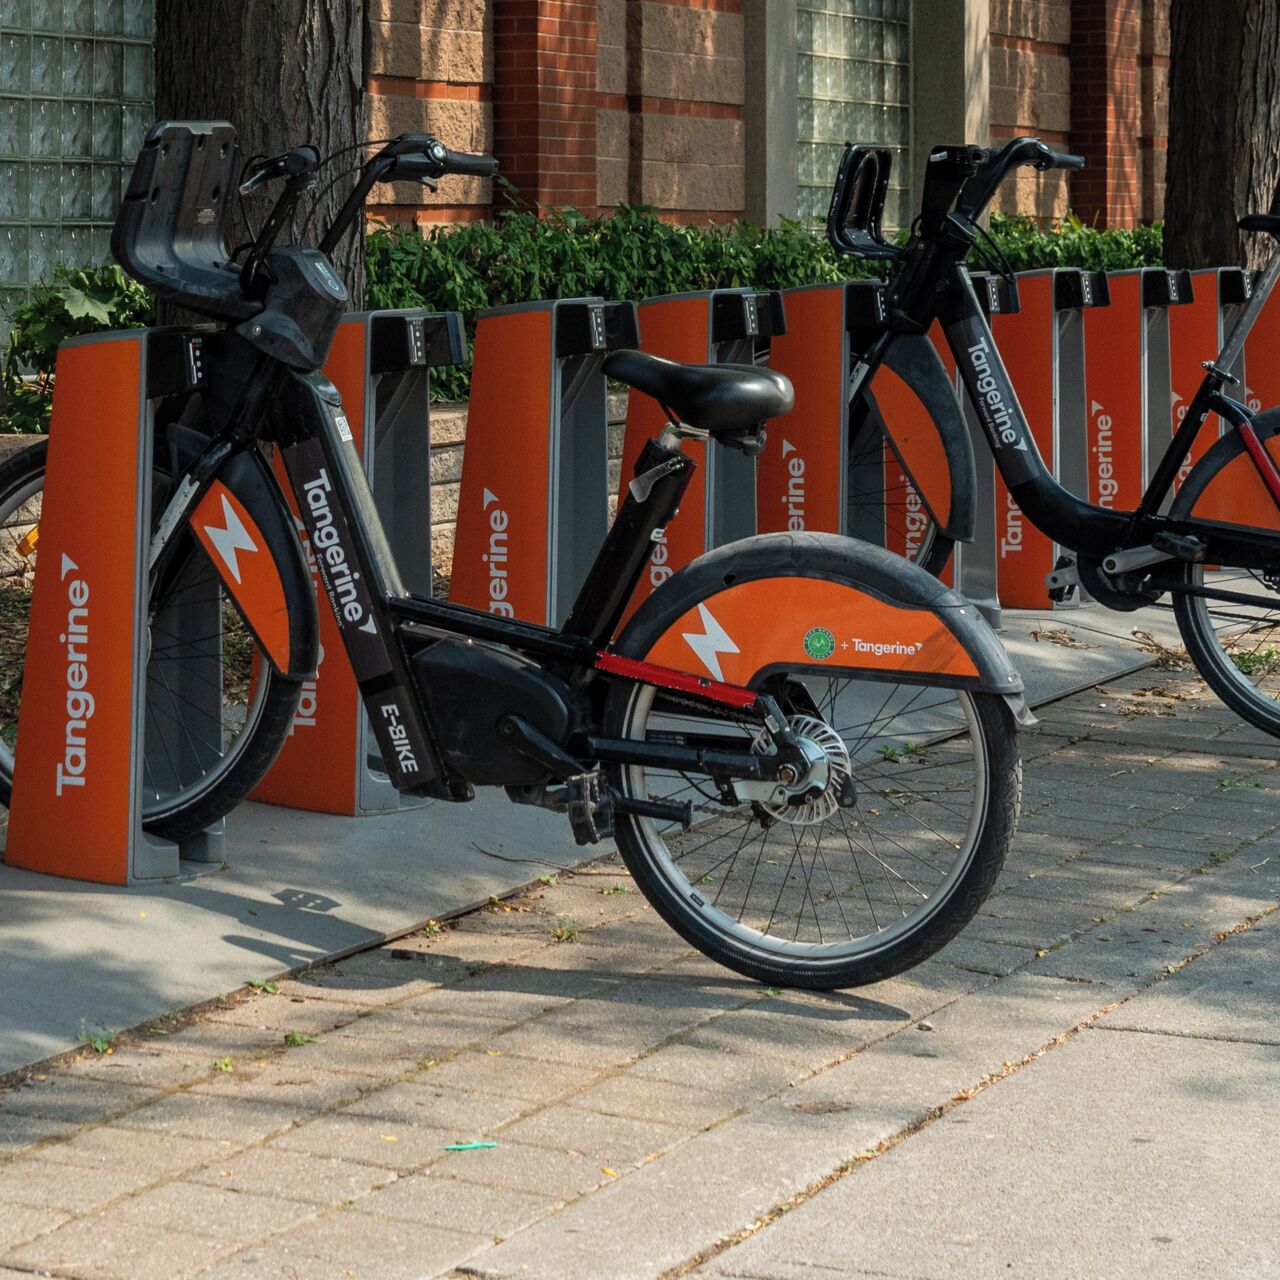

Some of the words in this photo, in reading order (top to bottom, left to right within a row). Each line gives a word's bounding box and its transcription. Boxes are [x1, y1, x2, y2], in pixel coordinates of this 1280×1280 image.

[968, 336, 1016, 444] Tangerine
[781, 457, 805, 531] erine
[1092, 414, 1118, 509] ngerine
[304, 468, 363, 622] Tangerine
[482, 509, 515, 618] gerine
[56, 579, 95, 796] Tangerine
[852, 638, 915, 656] Tangerine
[381, 704, 419, 774] E-BIKE
